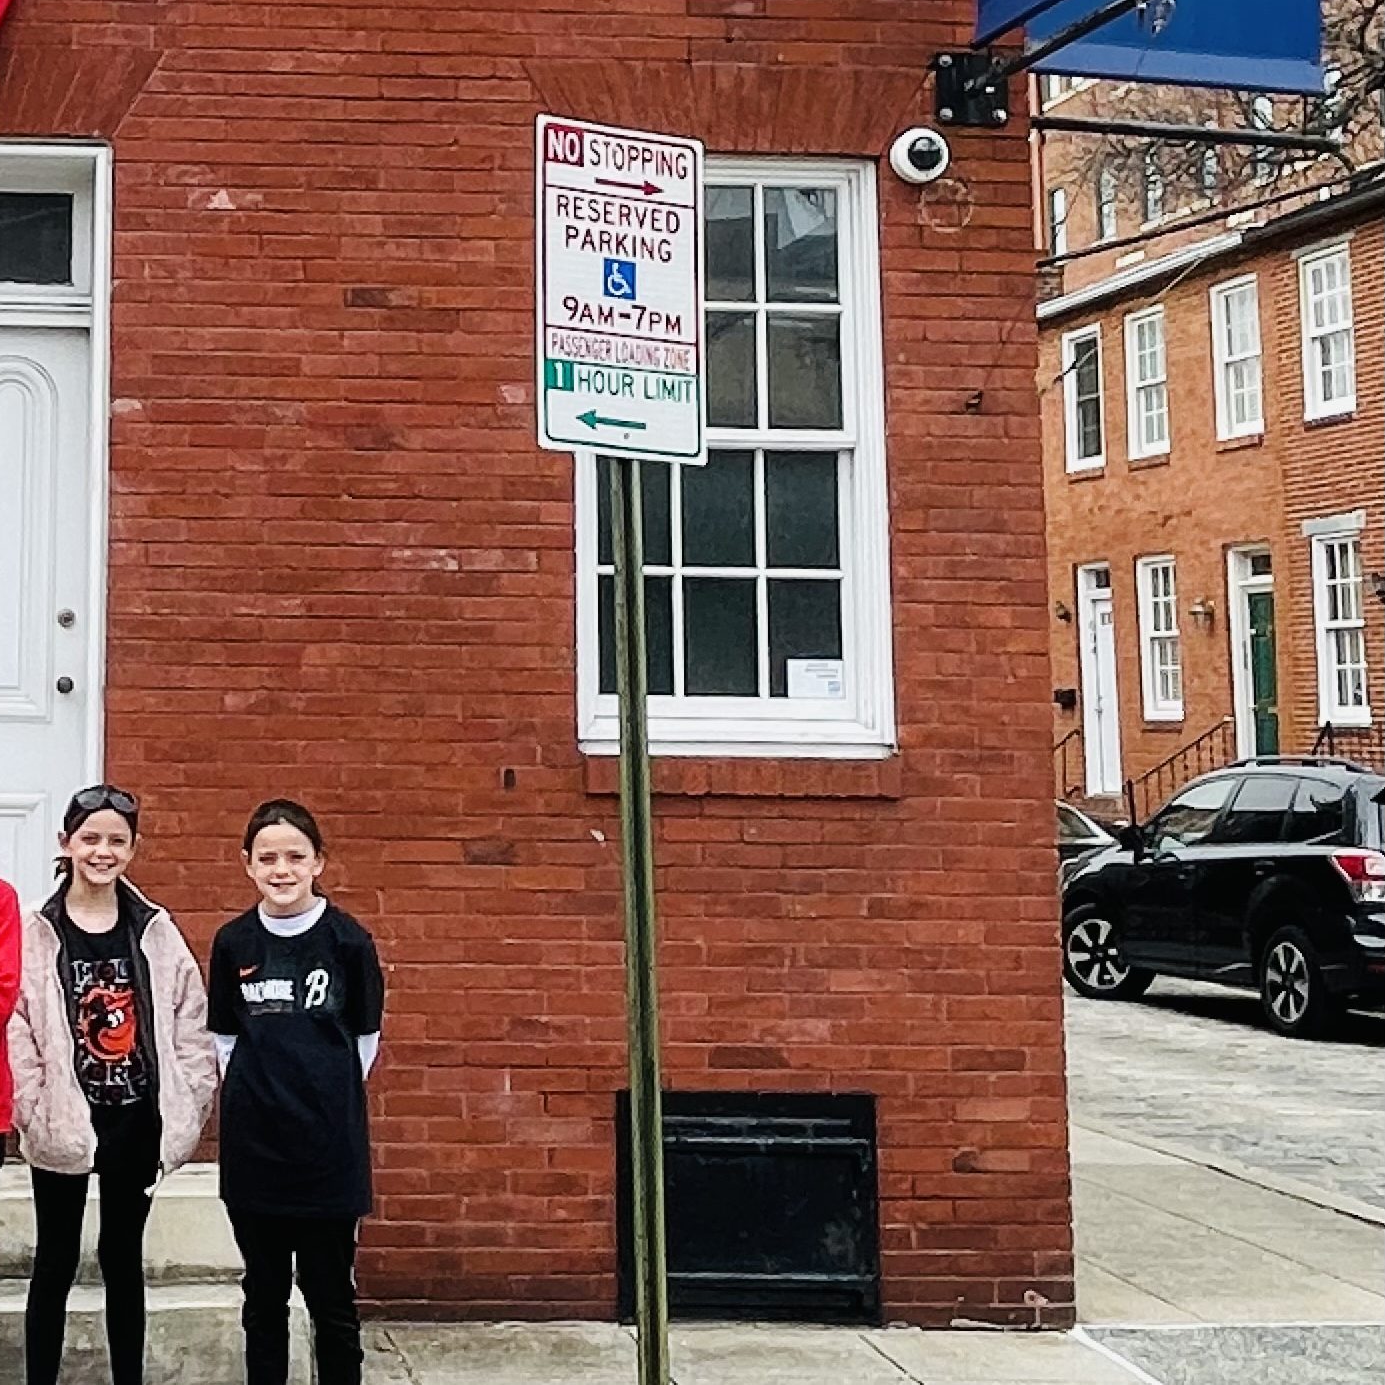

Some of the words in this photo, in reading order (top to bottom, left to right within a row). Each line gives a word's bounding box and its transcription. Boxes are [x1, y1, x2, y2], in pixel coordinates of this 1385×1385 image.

[547, 128, 580, 163] NO
[589, 138, 688, 180] STOPPING
[556, 194, 681, 234] RESERVED
[565, 224, 672, 263] PARKING
[562, 296, 681, 336] 9AM-7PM
[551, 332, 612, 362] PASSENGER
[615, 340, 661, 367] LOADING
[664, 346, 691, 372] ZONE
[553, 361, 563, 388] 1
[578, 368, 635, 398] HOUR
[644, 375, 693, 404] LIMIT
[303, 968, 329, 1010] B
